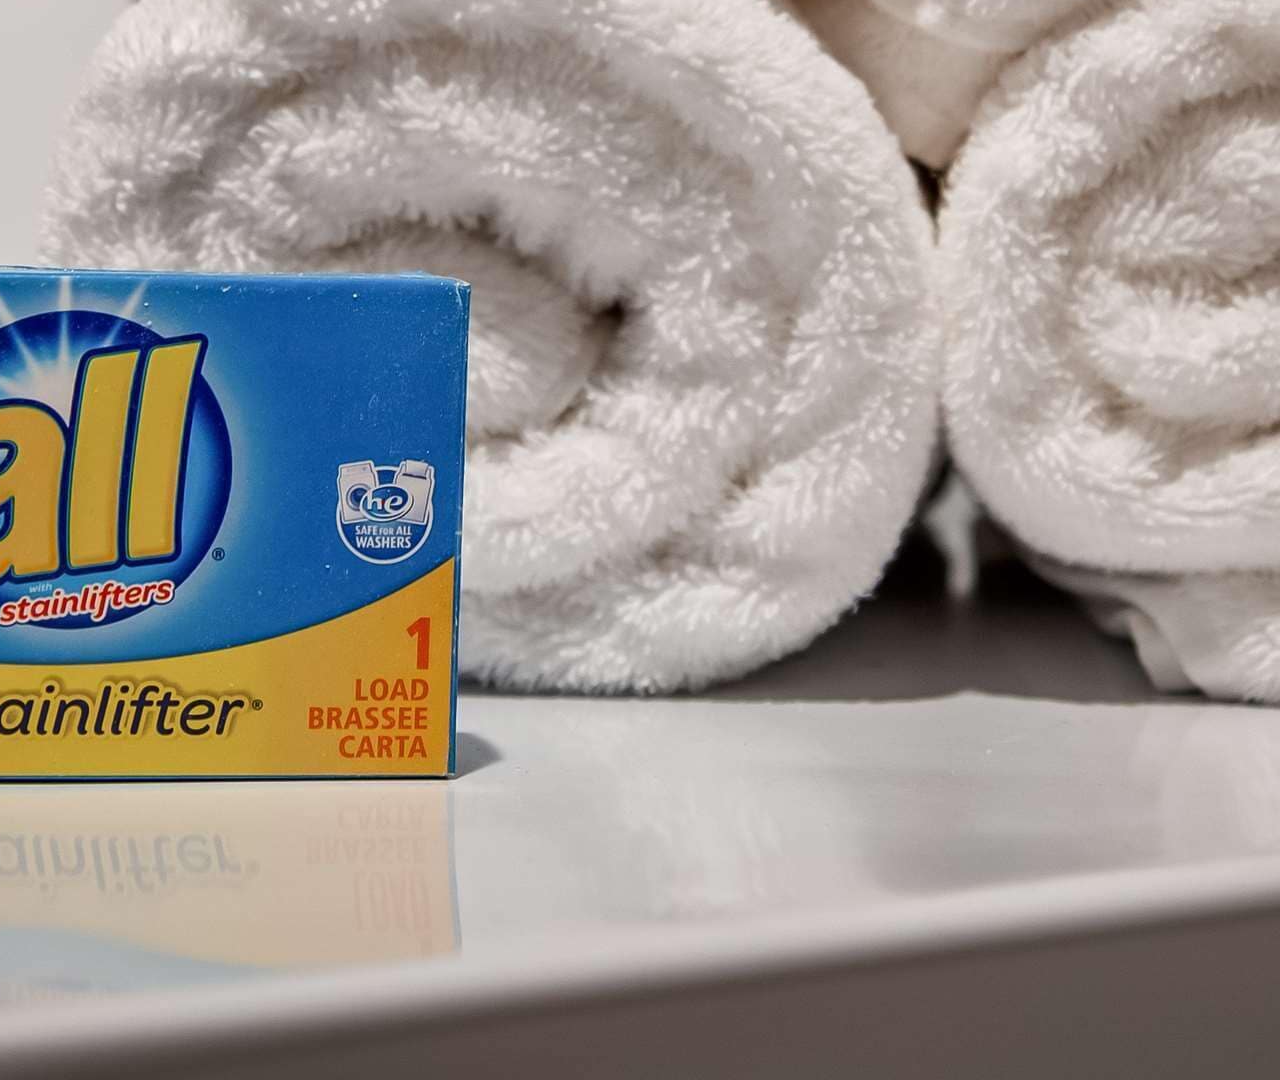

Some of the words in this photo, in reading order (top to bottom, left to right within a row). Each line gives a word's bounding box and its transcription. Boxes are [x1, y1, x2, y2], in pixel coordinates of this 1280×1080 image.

[366, 489, 404, 514] he
[355, 525, 378, 536] SAFE
[379, 526, 394, 536] FOR
[395, 525, 413, 536] ALL
[355, 536, 412, 549] WASHERS
[28, 581, 53, 594] with
[405, 616, 431, 670] 1
[354, 678, 430, 702] LOAD
[307, 706, 429, 730] BRASSEE
[337, 734, 428, 759] CARTA
